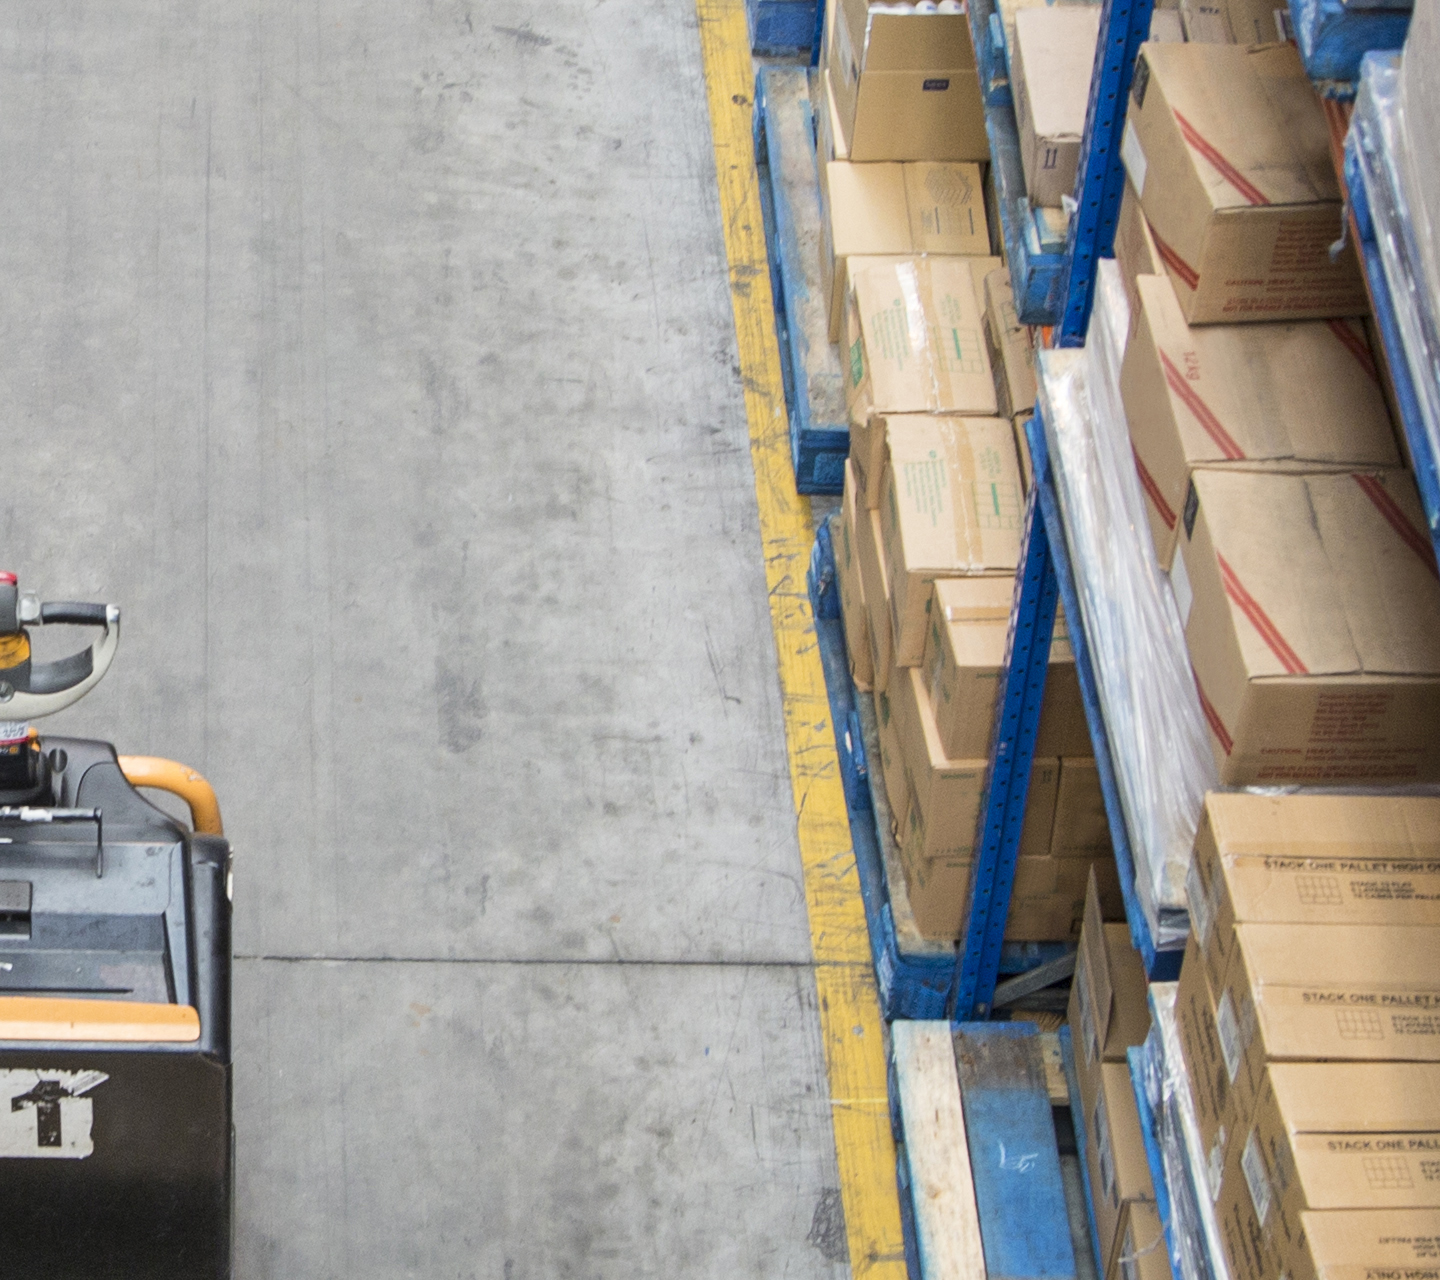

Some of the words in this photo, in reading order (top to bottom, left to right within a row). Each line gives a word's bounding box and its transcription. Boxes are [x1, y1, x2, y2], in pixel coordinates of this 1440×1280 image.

[1263, 858, 1304, 870] STACK
[1309, 860, 1335, 871] ONE
[1340, 862, 1388, 872] PALLET
[1391, 862, 1424, 873] HIGH
[1302, 992, 1344, 1002] STACK
[1349, 994, 1376, 1003] ONE
[1380, 995, 1430, 1005] PALLET
[1327, 1141, 1370, 1151] STACK
[1375, 1140, 1402, 1150] ONE
[1404, 1270, 1439, 1280] HIGH
